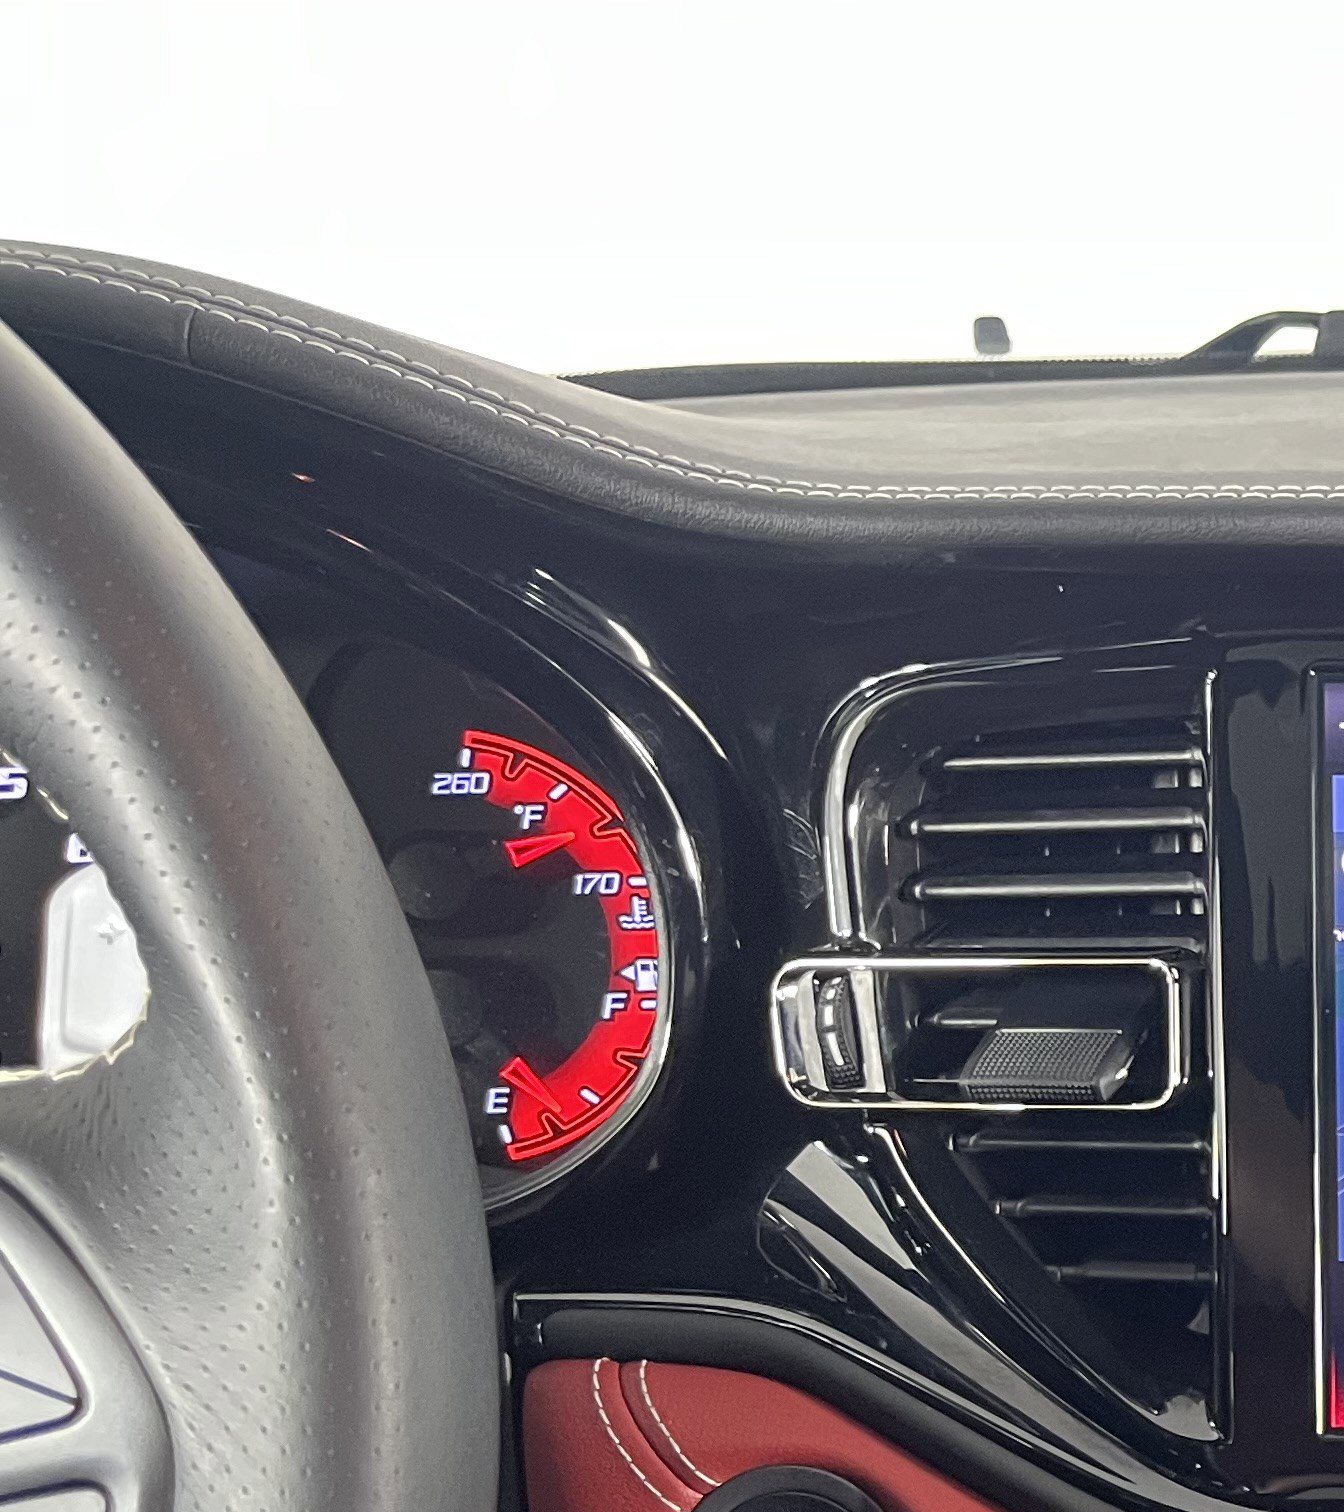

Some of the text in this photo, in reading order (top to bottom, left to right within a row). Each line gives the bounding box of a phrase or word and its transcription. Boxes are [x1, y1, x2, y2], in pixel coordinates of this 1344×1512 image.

[432, 772, 490, 795] 260
[514, 804, 545, 829] °F
[573, 873, 620, 895] 170
[602, 992, 628, 1019] F
[485, 1086, 509, 1114] E
